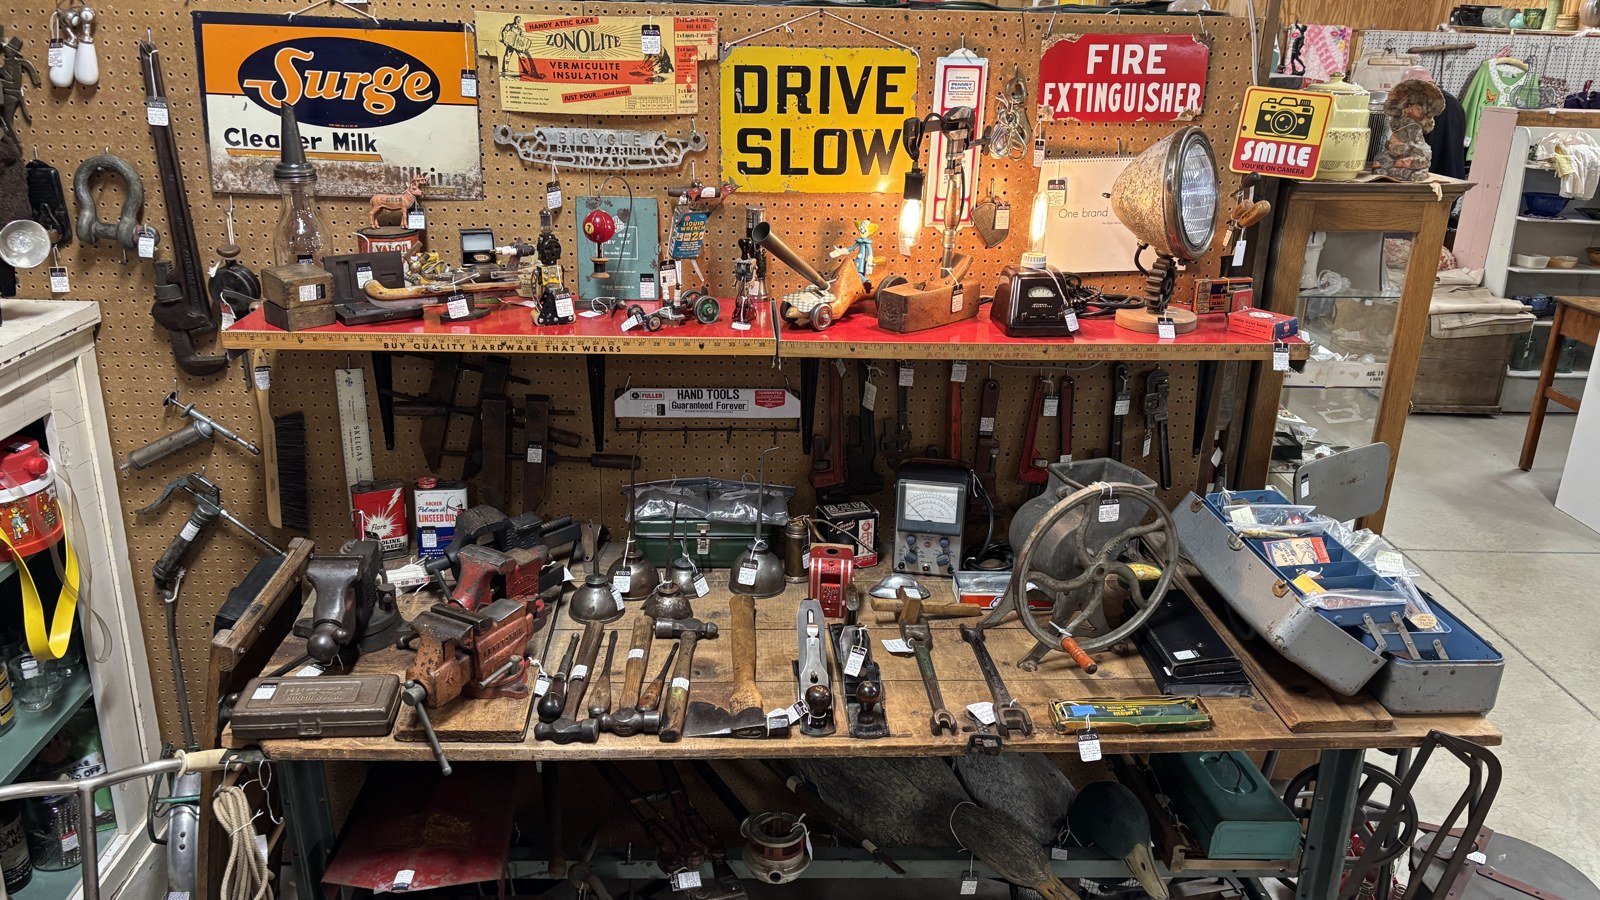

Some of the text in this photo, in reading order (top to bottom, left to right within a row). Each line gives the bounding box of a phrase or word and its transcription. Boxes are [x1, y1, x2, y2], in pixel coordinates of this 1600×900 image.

[529, 22, 551, 30] HANDY
[576, 17, 594, 25] RAKE
[545, 28, 622, 53] ZONOLITE
[1086, 43, 1168, 75] FIRE
[549, 61, 621, 71] VERMICULITE
[244, 47, 433, 115] Surge
[552, 71, 619, 81] INSULATION
[733, 65, 906, 115] DRIVE
[563, 93, 578, 101] JUST
[1042, 81, 1202, 113] EXTINGUISHER
[224, 127, 377, 152] Cleaer Milk
[558, 132, 642, 147] BICYCLE
[556, 145, 647, 156] BALL BEARING
[736, 127, 903, 176] SLOW
[1240, 140, 1312, 167] SMILE
[1241, 162, 1305, 175] YOU'RE ON CAMERA
[1058, 207, 1109, 219] One brand
[413, 342, 465, 350] QUALITY
[472, 343, 538, 351] HARDWARE
[582, 345, 621, 353] WEARS
[677, 389, 740, 400] HAND TOOLS
[671, 401, 747, 410] Guaranteed Forever
[353, 425, 364, 462] SKELGAS
[418, 513, 455, 523] LINSEED OIL
